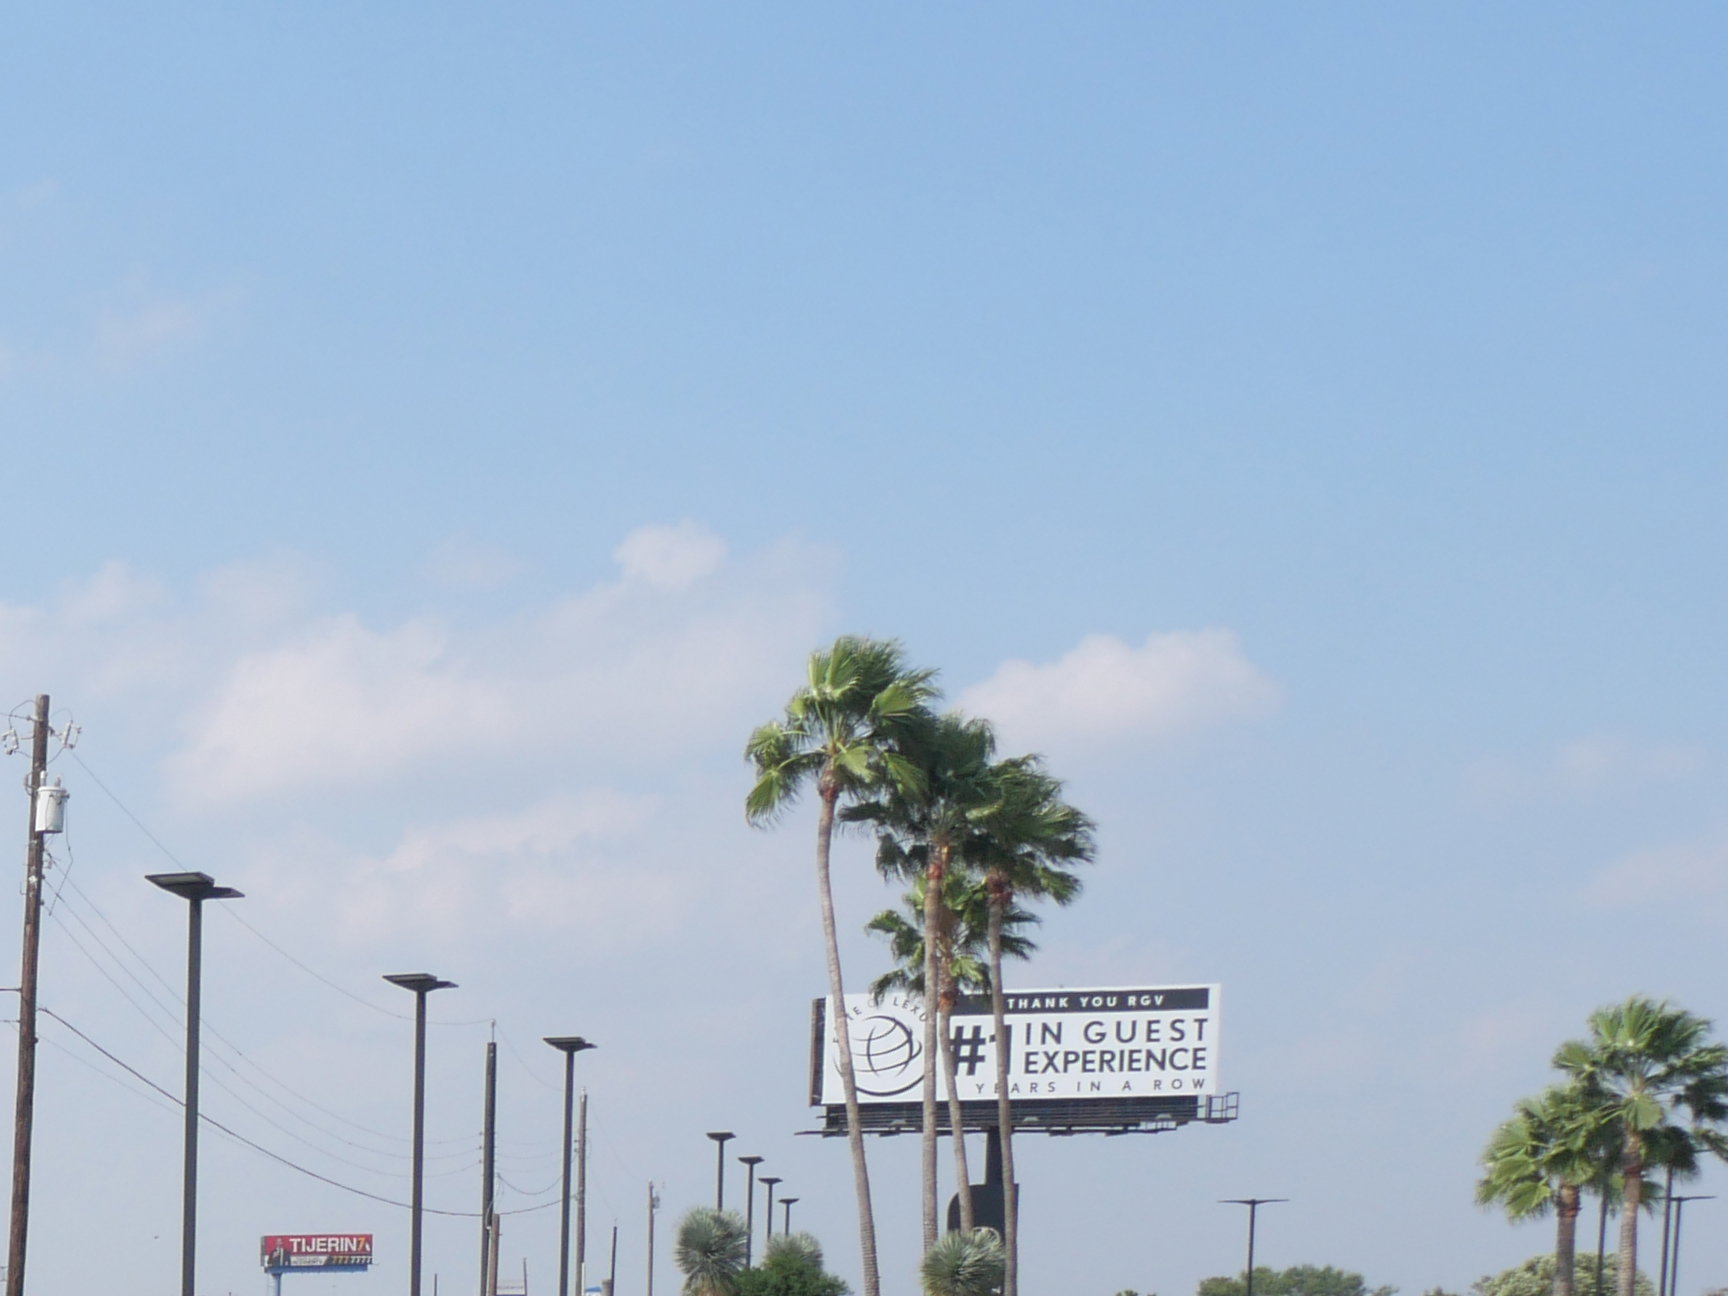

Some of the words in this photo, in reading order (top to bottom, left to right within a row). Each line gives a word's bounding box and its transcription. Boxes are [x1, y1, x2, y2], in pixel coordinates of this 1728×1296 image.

[1008, 997, 1069, 1009] THANK
[1080, 996, 1117, 1007] YOU
[1128, 995, 1164, 1006] RGV
[1026, 1022, 1062, 1045] IN
[1084, 1018, 1208, 1044] GUEST
[950, 1025, 1012, 1076] #1
[1024, 1048, 1206, 1074] EXPERIENCE
[1077, 1081, 1101, 1092] IN
[1122, 1080, 1132, 1091] A
[1154, 1078, 1205, 1090] ROW
